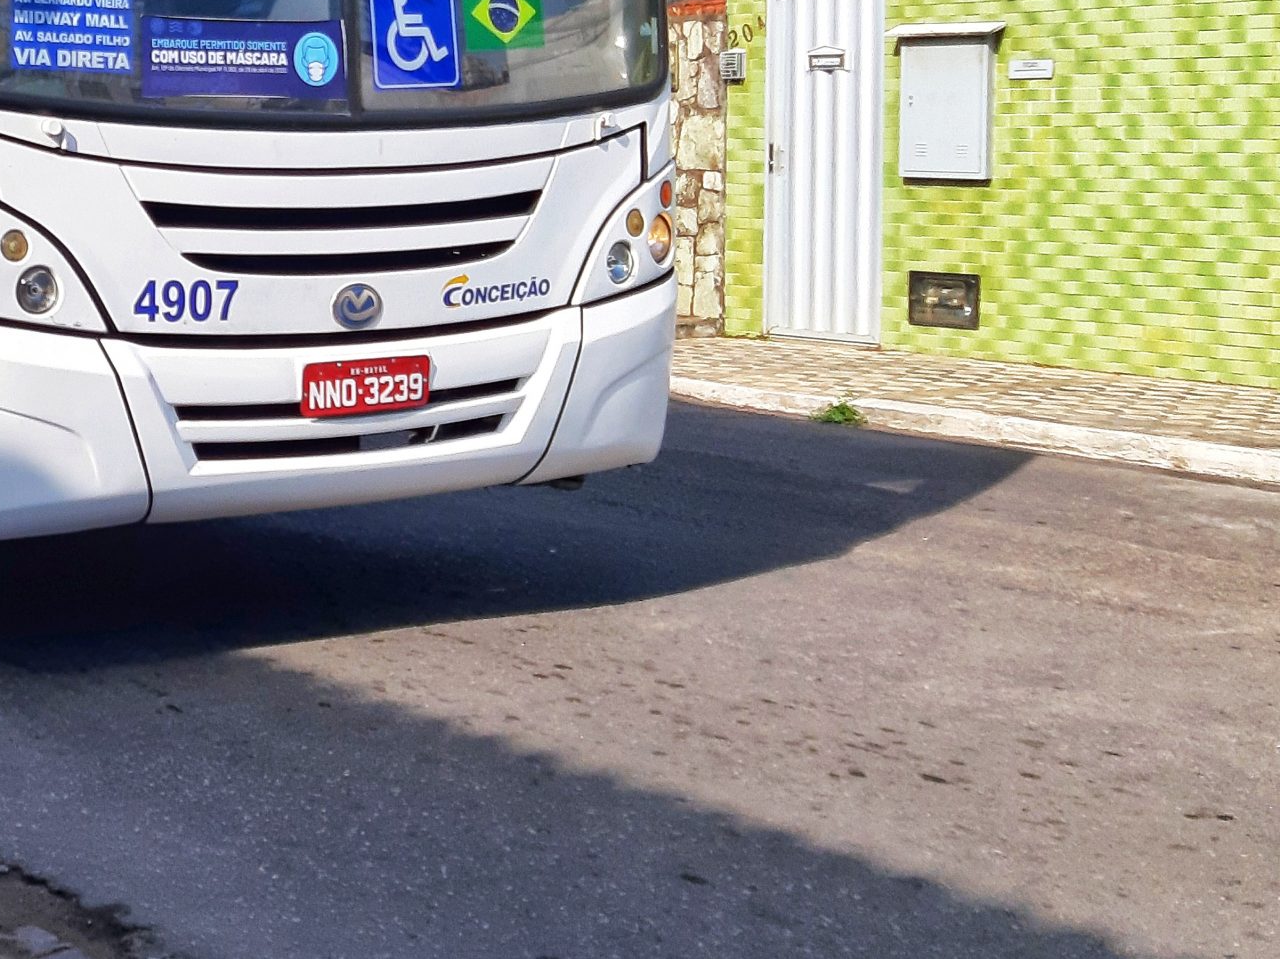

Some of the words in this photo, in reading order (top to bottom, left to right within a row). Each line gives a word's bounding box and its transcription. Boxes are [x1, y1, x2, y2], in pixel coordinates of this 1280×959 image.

[14, 10, 80, 26] MIDWAY
[85, 13, 129, 29] MALL
[14, 31, 33, 42] AV.
[36, 32, 93, 45] SALGADO
[95, 34, 130, 47] FILHO
[151, 39, 199, 49] EMBARQUE
[200, 40, 245, 50] PERMITIDO
[247, 41, 287, 51] SOMENTE
[14, 48, 52, 67] VIA
[56, 49, 130, 70] DIRETA
[151, 50, 179, 64] COM
[180, 50, 206, 64] USO
[207, 51, 225, 65] DE
[226, 50, 289, 66] MÁSCARA
[133, 280, 239, 322] 4907
[443, 276, 550, 307] CONCEIÇÃO
